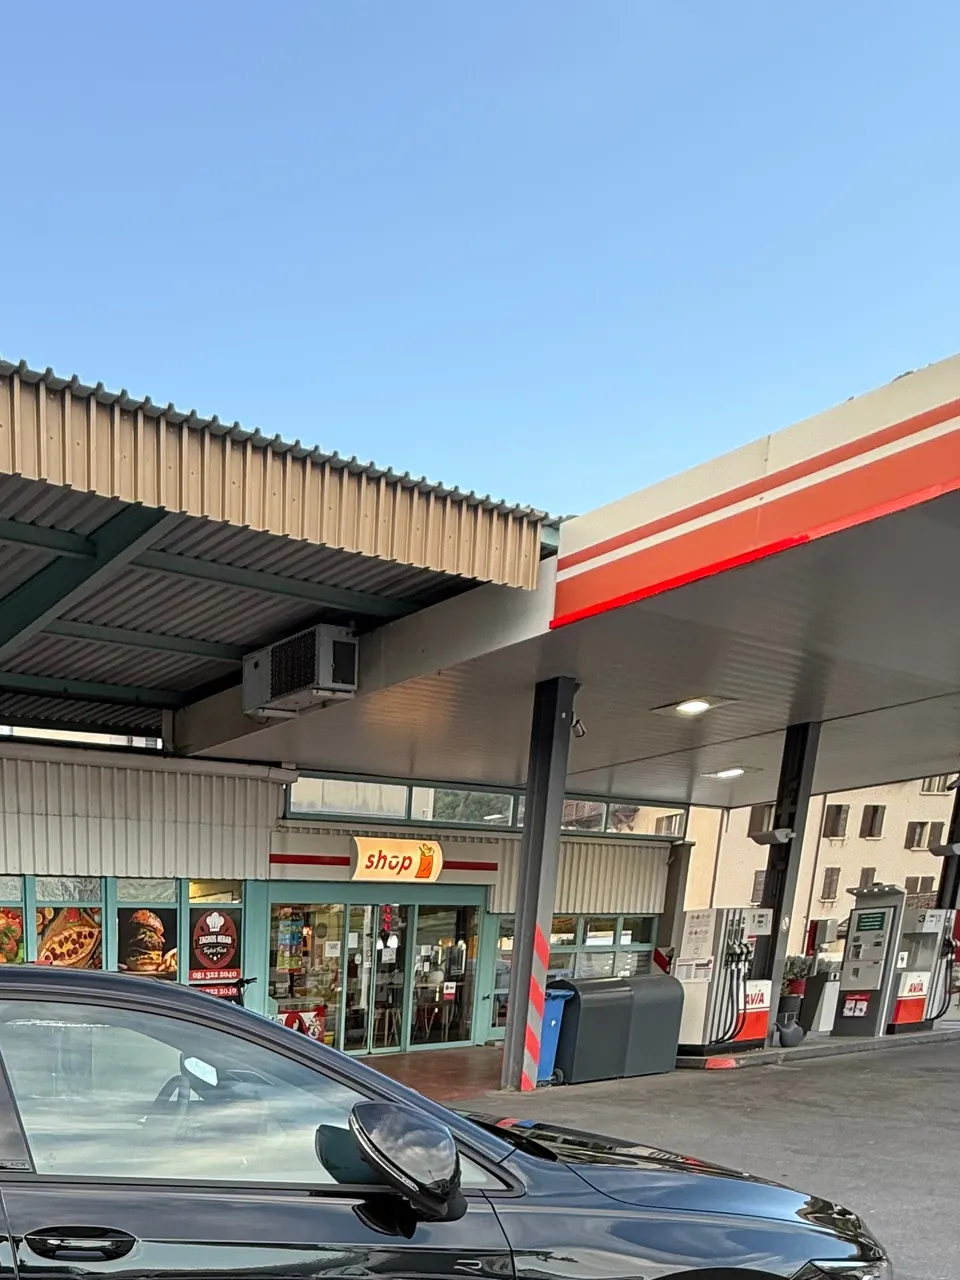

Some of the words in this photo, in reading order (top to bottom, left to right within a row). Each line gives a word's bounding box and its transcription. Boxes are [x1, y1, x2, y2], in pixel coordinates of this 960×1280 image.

[364, 850, 413, 876] shop
[919, 915, 926, 923] 3
[205, 971, 219, 979] 322
[219, 970, 237, 978] 2040
[908, 982, 924, 994] AVIA
[745, 992, 764, 1006] AVIA
